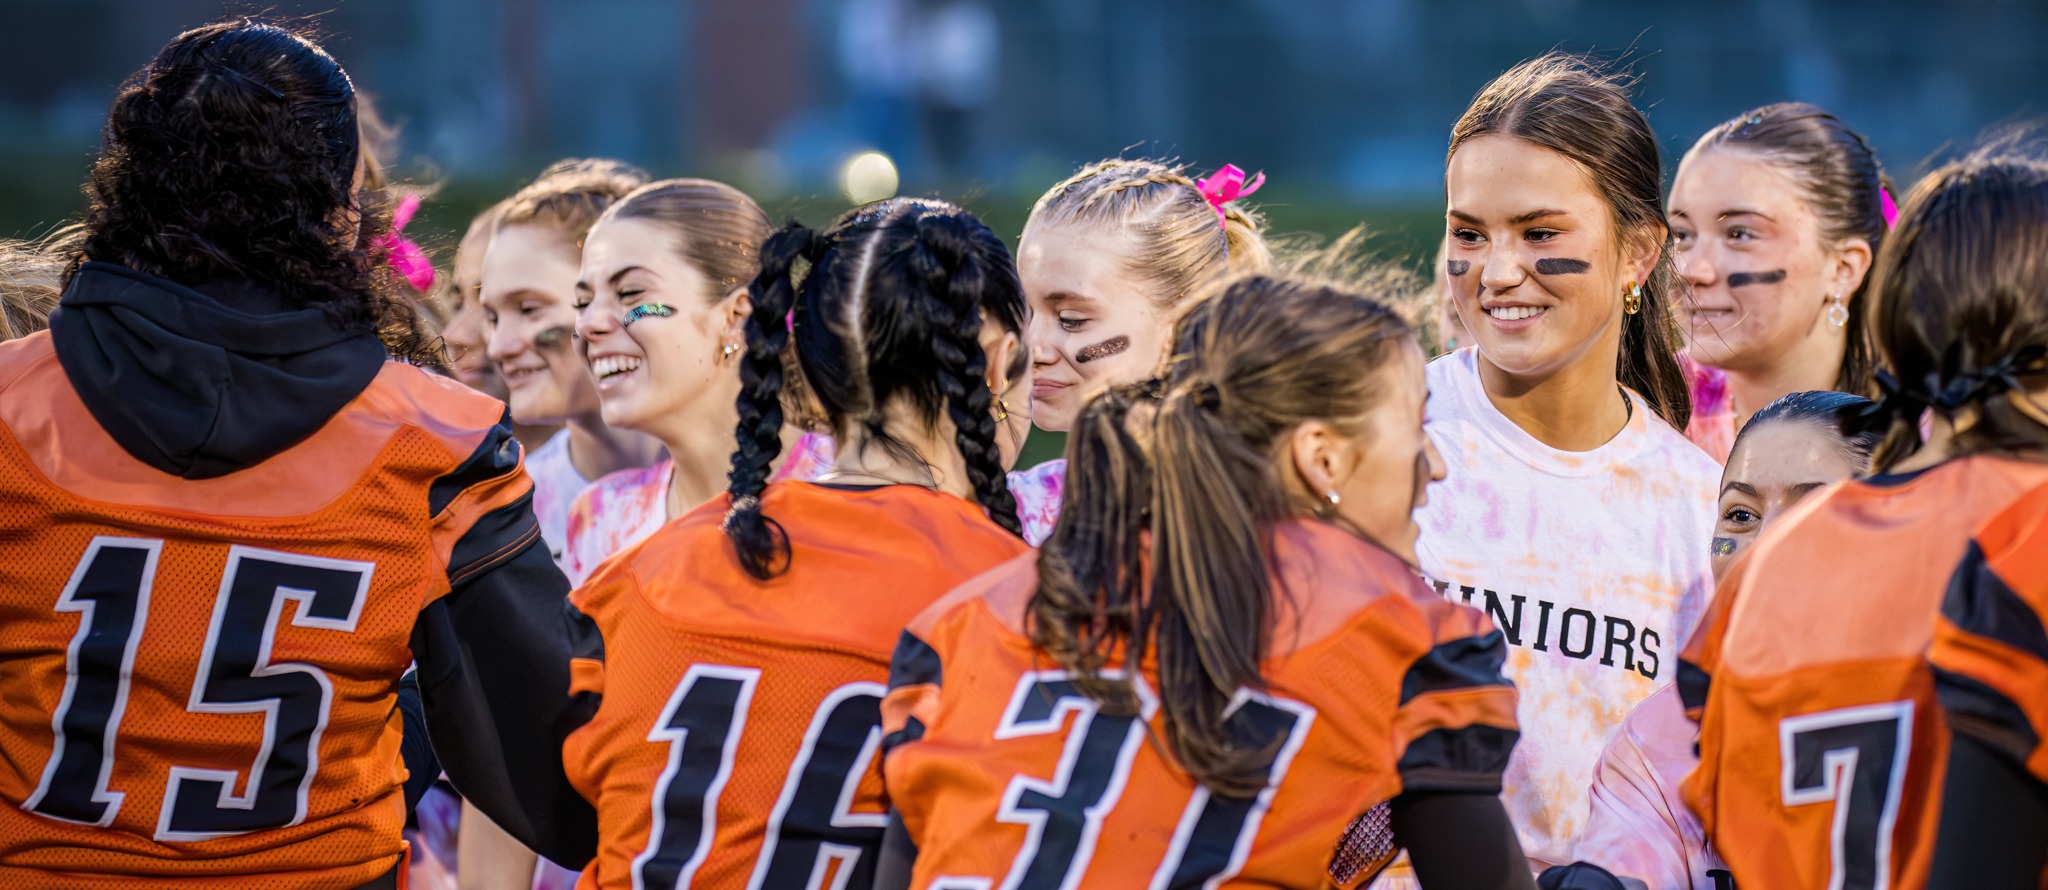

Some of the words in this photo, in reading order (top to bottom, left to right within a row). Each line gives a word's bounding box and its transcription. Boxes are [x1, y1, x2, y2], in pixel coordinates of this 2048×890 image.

[20, 535, 376, 842] 15
[1420, 576, 1662, 682] NIORS
[926, 668, 1318, 890] 31
[1779, 699, 1915, 890] 7
